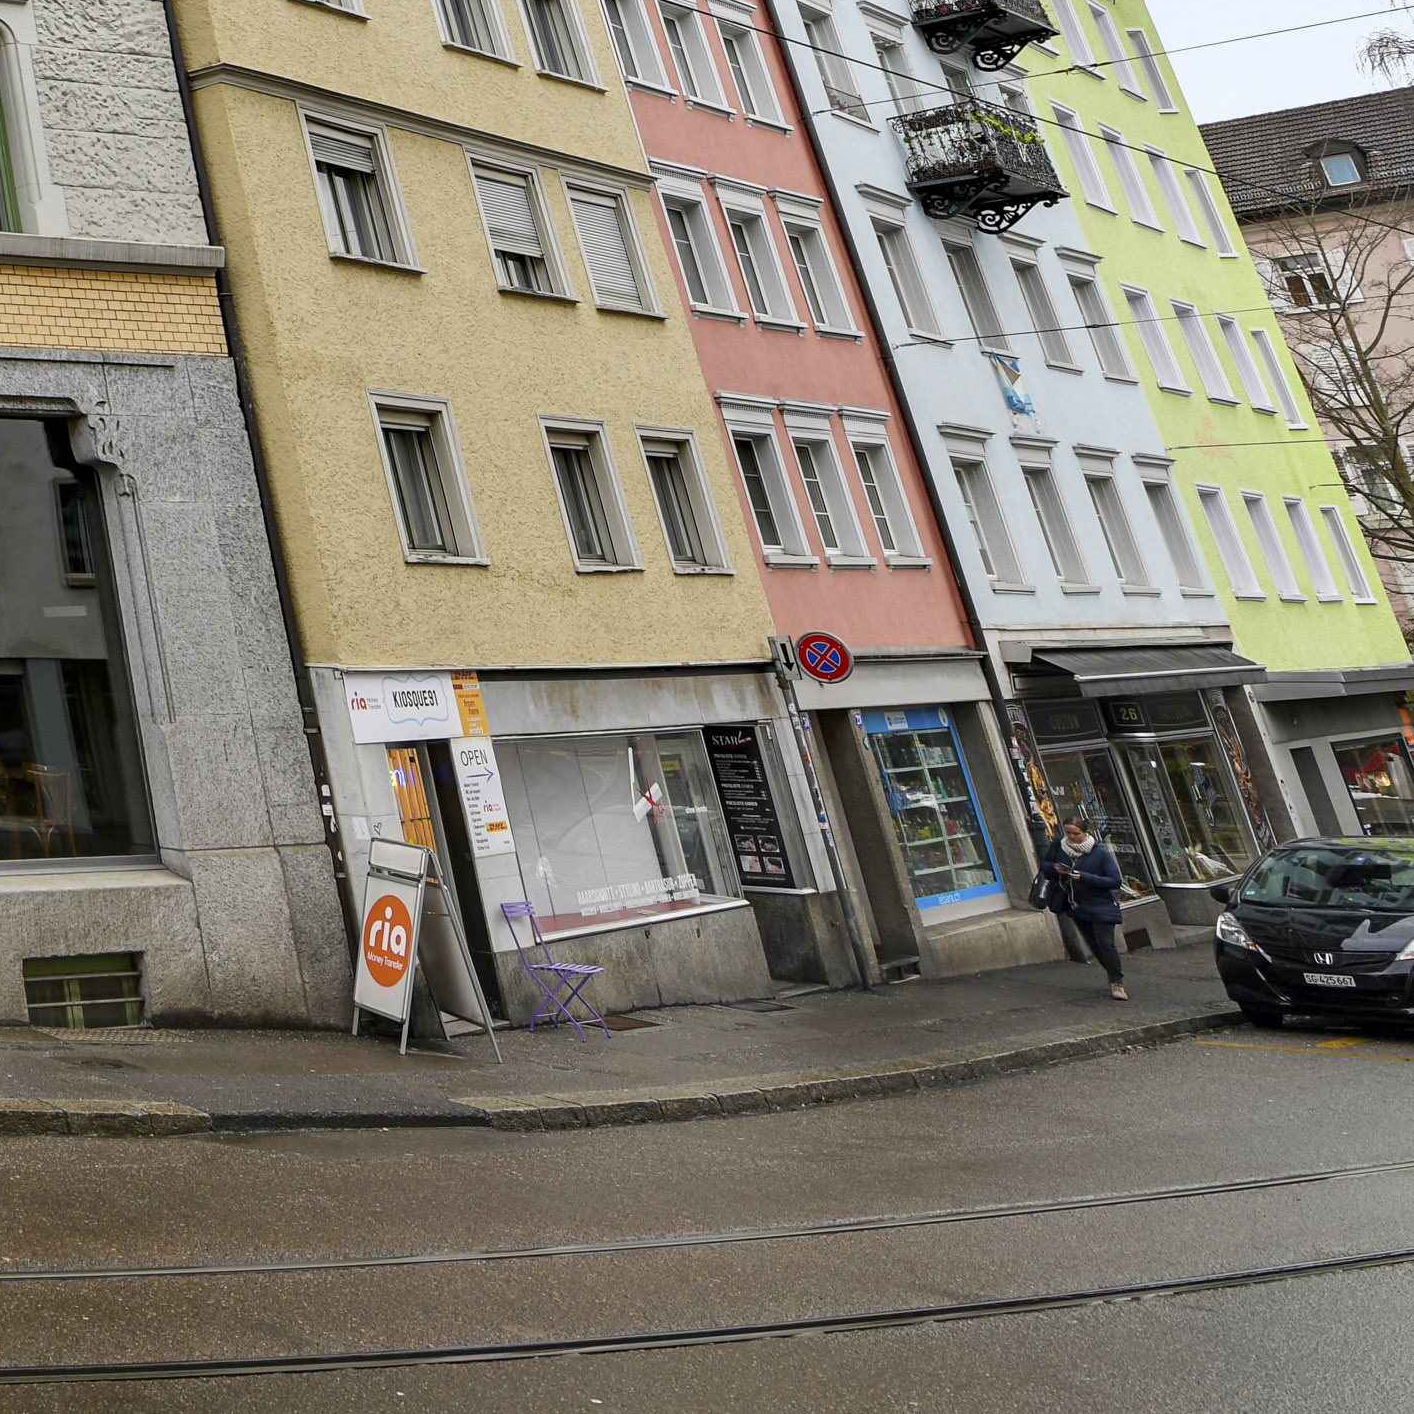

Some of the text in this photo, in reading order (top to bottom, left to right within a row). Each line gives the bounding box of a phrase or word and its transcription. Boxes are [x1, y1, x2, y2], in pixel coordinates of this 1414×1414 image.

[351, 691, 367, 710] ria
[392, 689, 439, 710] KIOSQUE91
[1120, 707, 1138, 721] 26
[460, 749, 488, 766] OPEN
[488, 822, 506, 831] DHL
[368, 906, 407, 957] ria
[367, 950, 404, 971] Money Transfer
